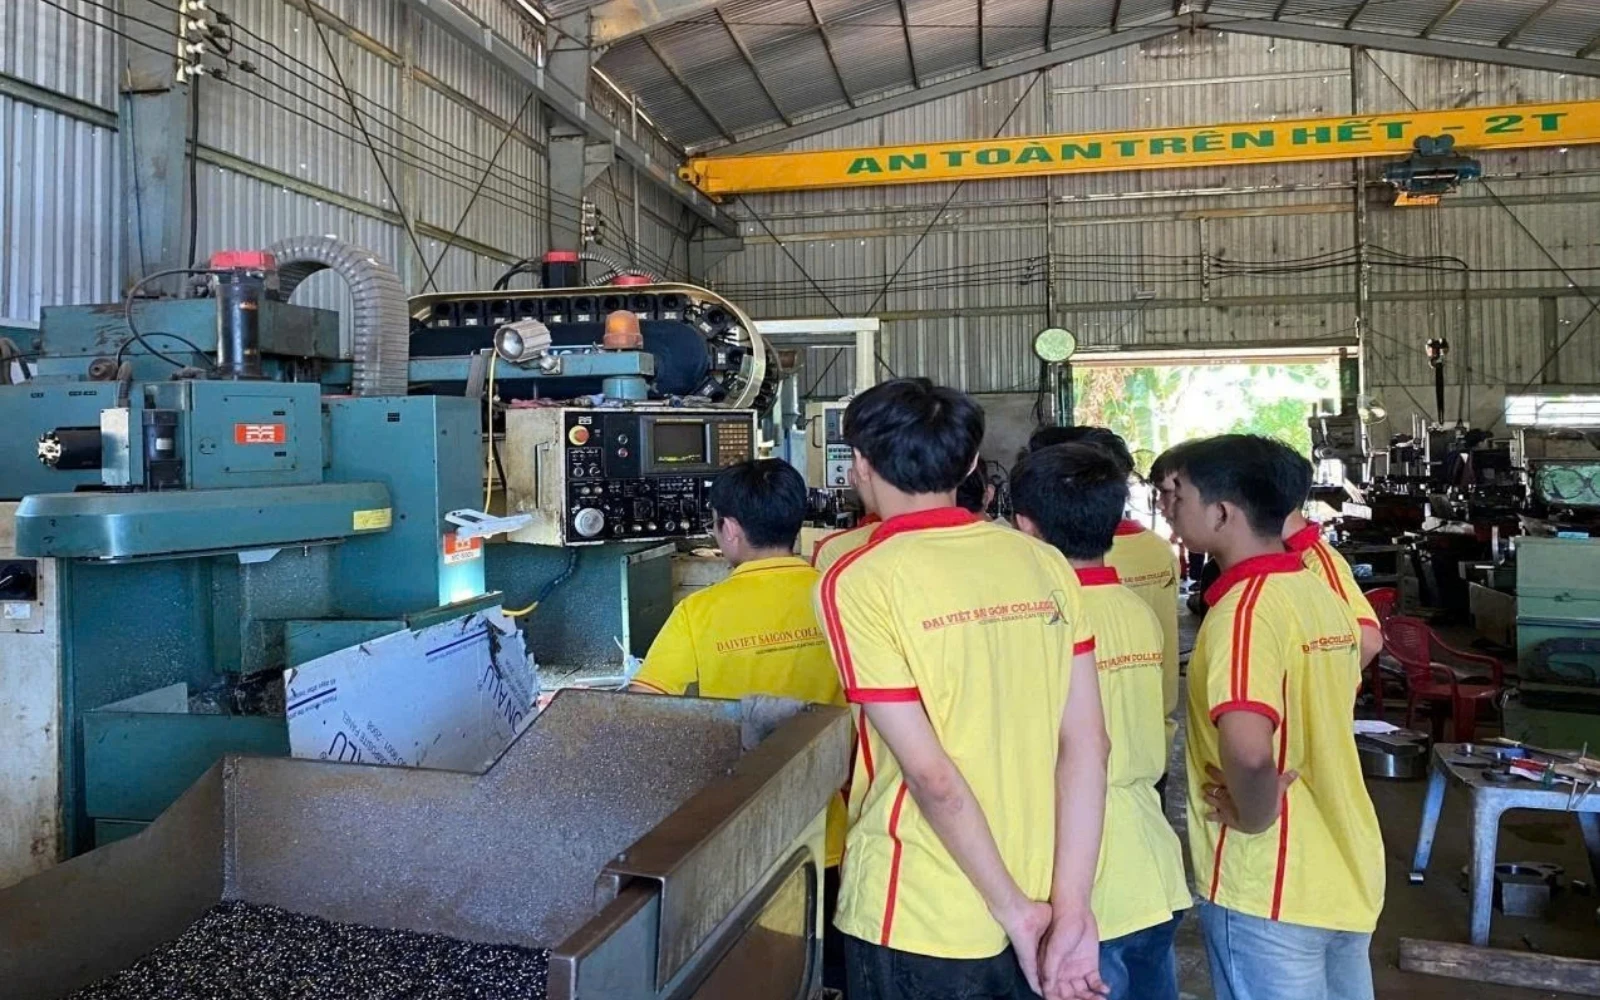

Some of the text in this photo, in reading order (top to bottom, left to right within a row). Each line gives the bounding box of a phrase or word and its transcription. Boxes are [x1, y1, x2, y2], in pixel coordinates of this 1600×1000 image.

[847, 153, 927, 174] AN
[940, 141, 1101, 167] TOÀN
[1111, 130, 1275, 157] TRÊN
[1291, 117, 1412, 145] HẾT
[1484, 112, 1568, 134] 2T
